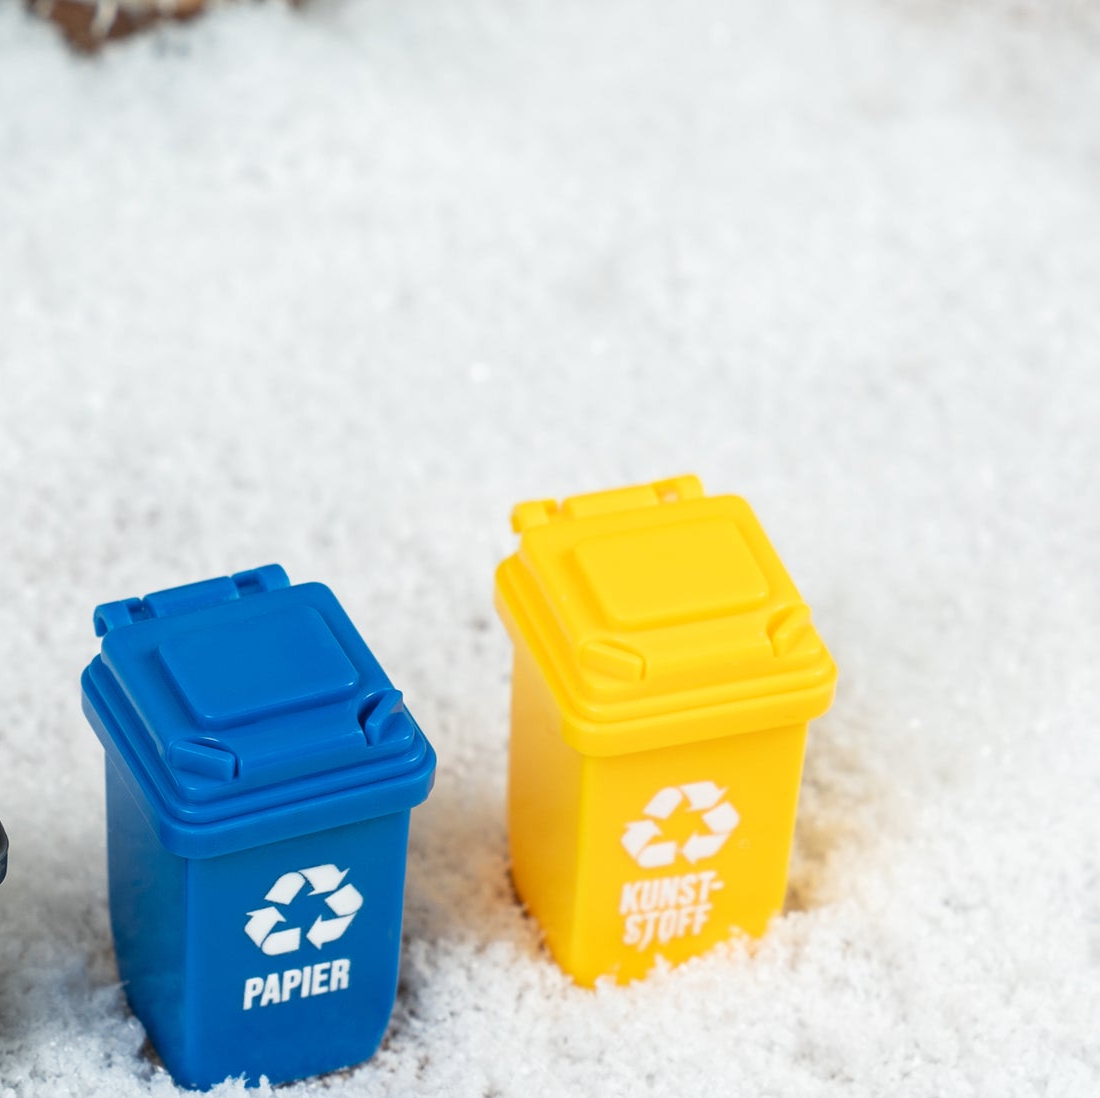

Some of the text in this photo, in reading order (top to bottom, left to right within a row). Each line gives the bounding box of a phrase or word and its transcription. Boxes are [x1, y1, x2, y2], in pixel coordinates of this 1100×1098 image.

[619, 870, 725, 915] KUNST-
[622, 902, 713, 952] STOFF
[243, 958, 351, 1011] PAPIER
